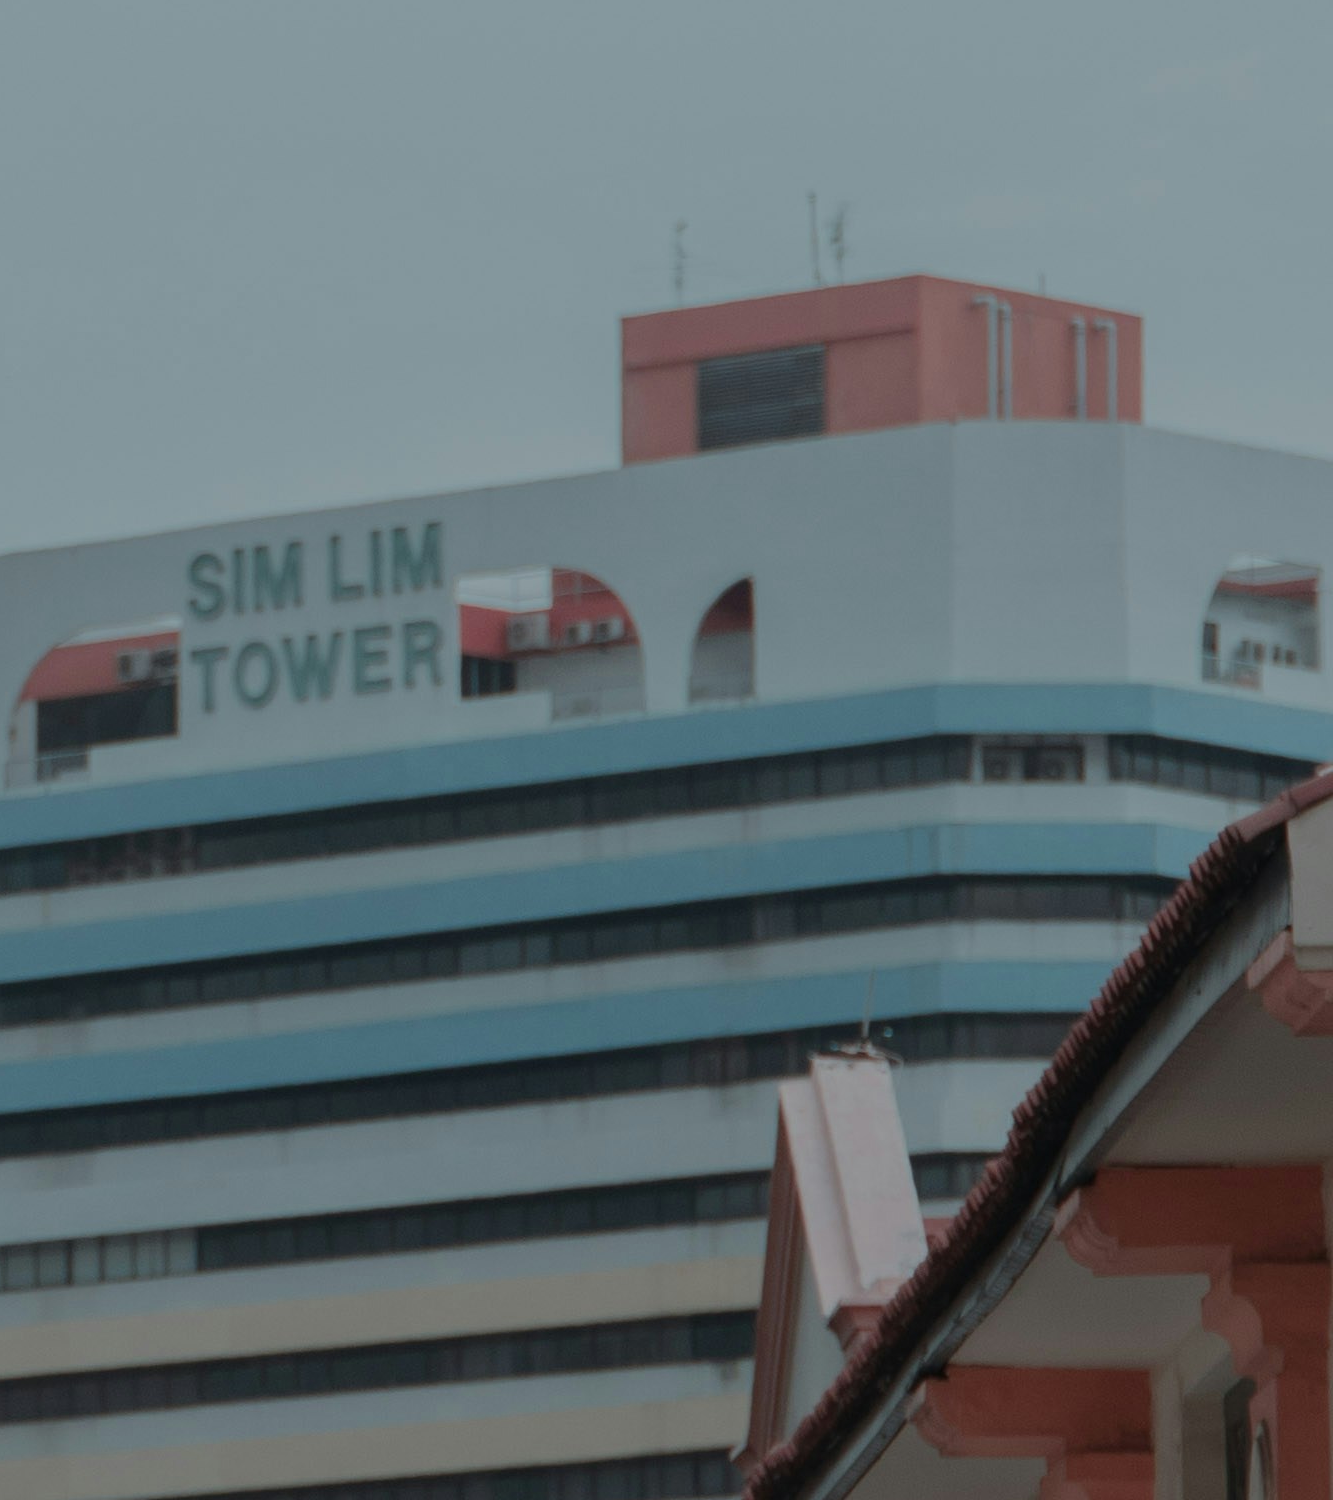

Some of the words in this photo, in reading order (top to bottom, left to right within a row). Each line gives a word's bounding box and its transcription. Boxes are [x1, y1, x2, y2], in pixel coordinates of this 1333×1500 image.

[189, 540, 305, 621] SIM
[329, 521, 444, 599] LIM
[190, 619, 443, 714] TOWER
